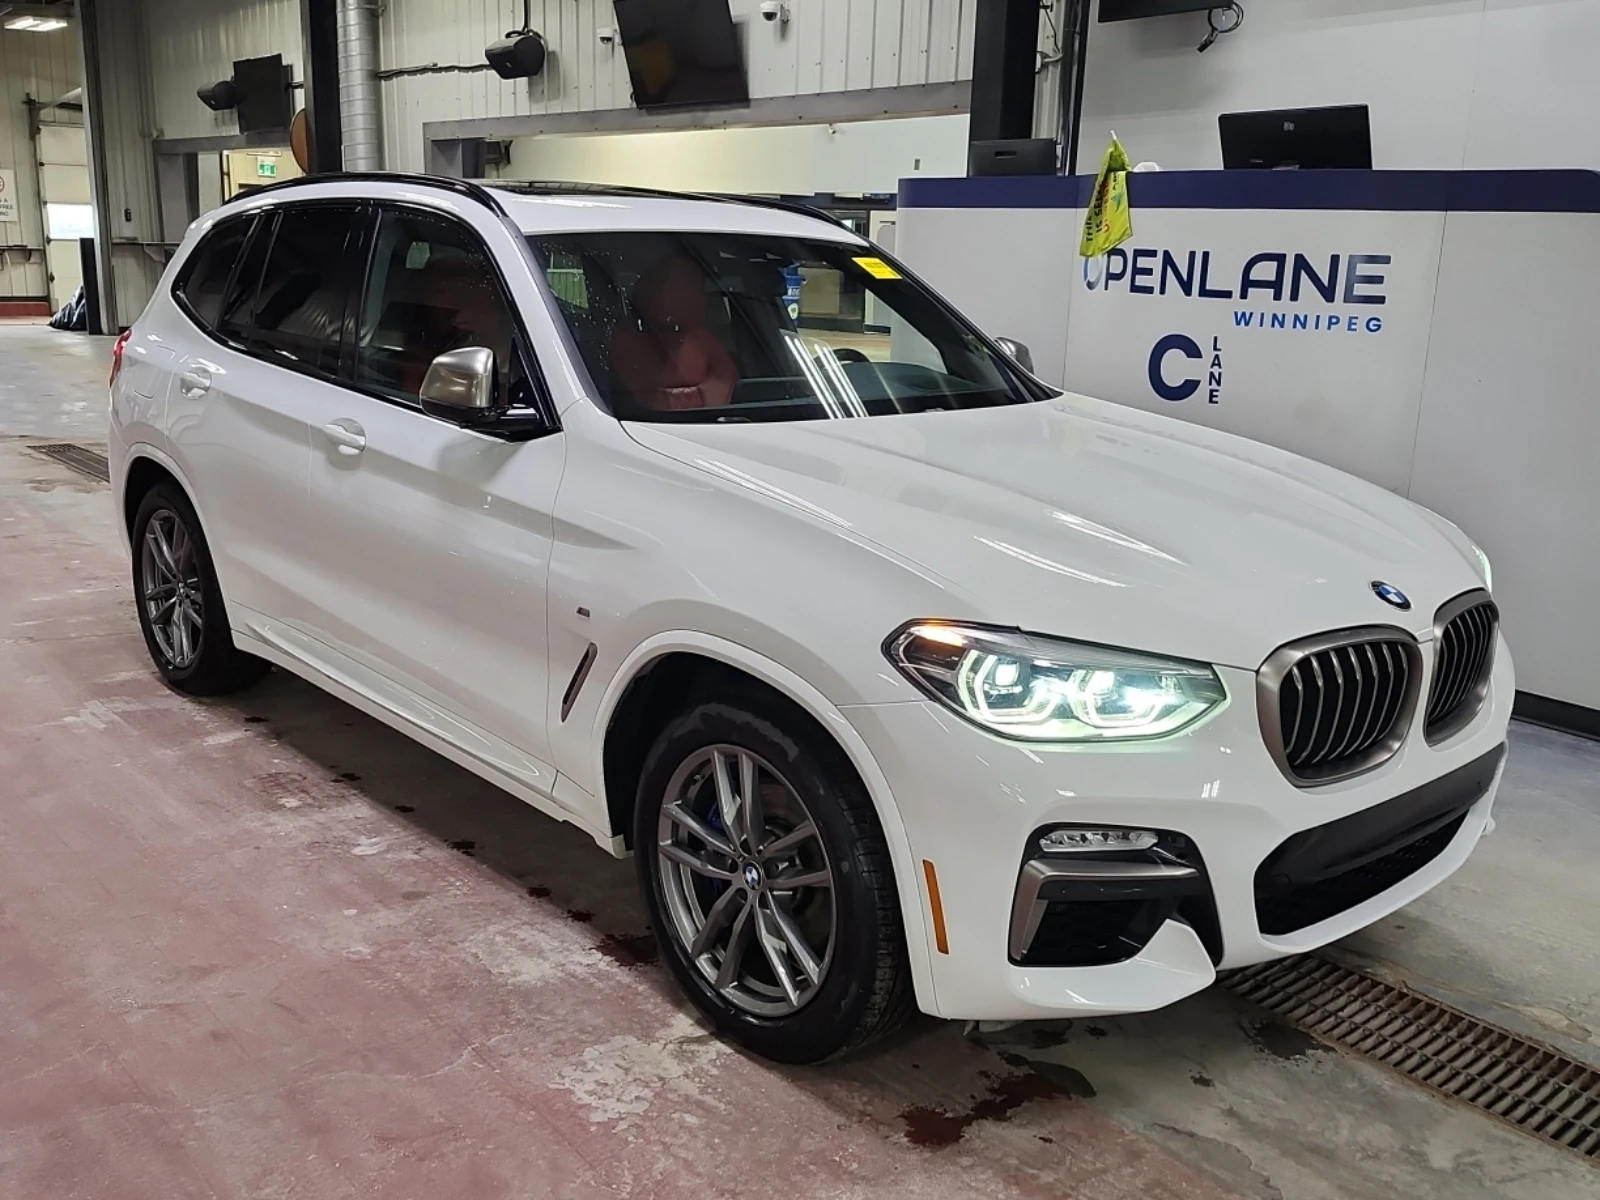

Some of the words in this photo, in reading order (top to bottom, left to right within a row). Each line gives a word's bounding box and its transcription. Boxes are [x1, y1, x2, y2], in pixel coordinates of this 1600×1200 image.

[1083, 247, 1392, 305] OPENLANE
[1233, 311, 1383, 333] WINNIPEG
[1148, 333, 1204, 402] C
[1208, 336, 1223, 404] LANE
